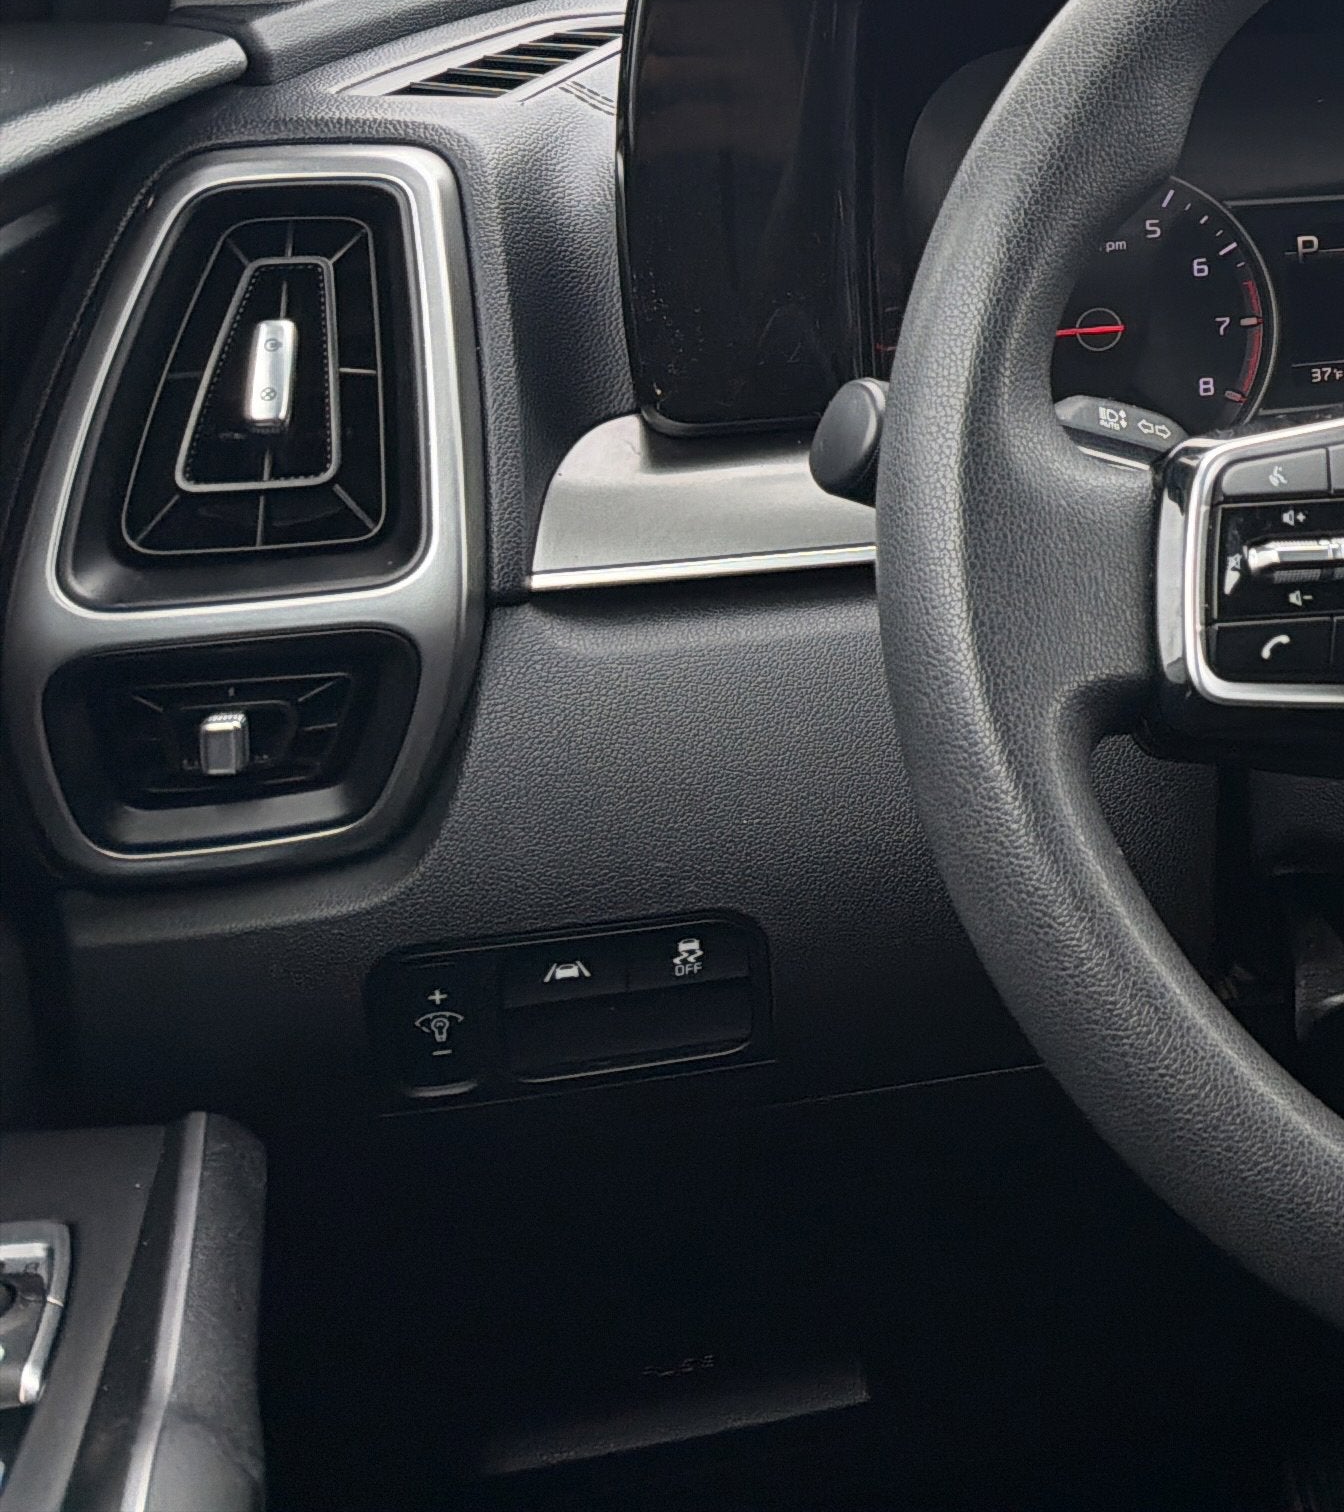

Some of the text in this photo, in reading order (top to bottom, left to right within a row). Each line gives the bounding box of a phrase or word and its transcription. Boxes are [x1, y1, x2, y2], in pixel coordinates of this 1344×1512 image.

[1145, 219, 1162, 238] 5
[1296, 235, 1319, 263] P
[1192, 258, 1209, 277] 6
[1214, 317, 1231, 336] 7
[1199, 377, 1215, 396] 8
[674, 962, 703, 977] OFF
